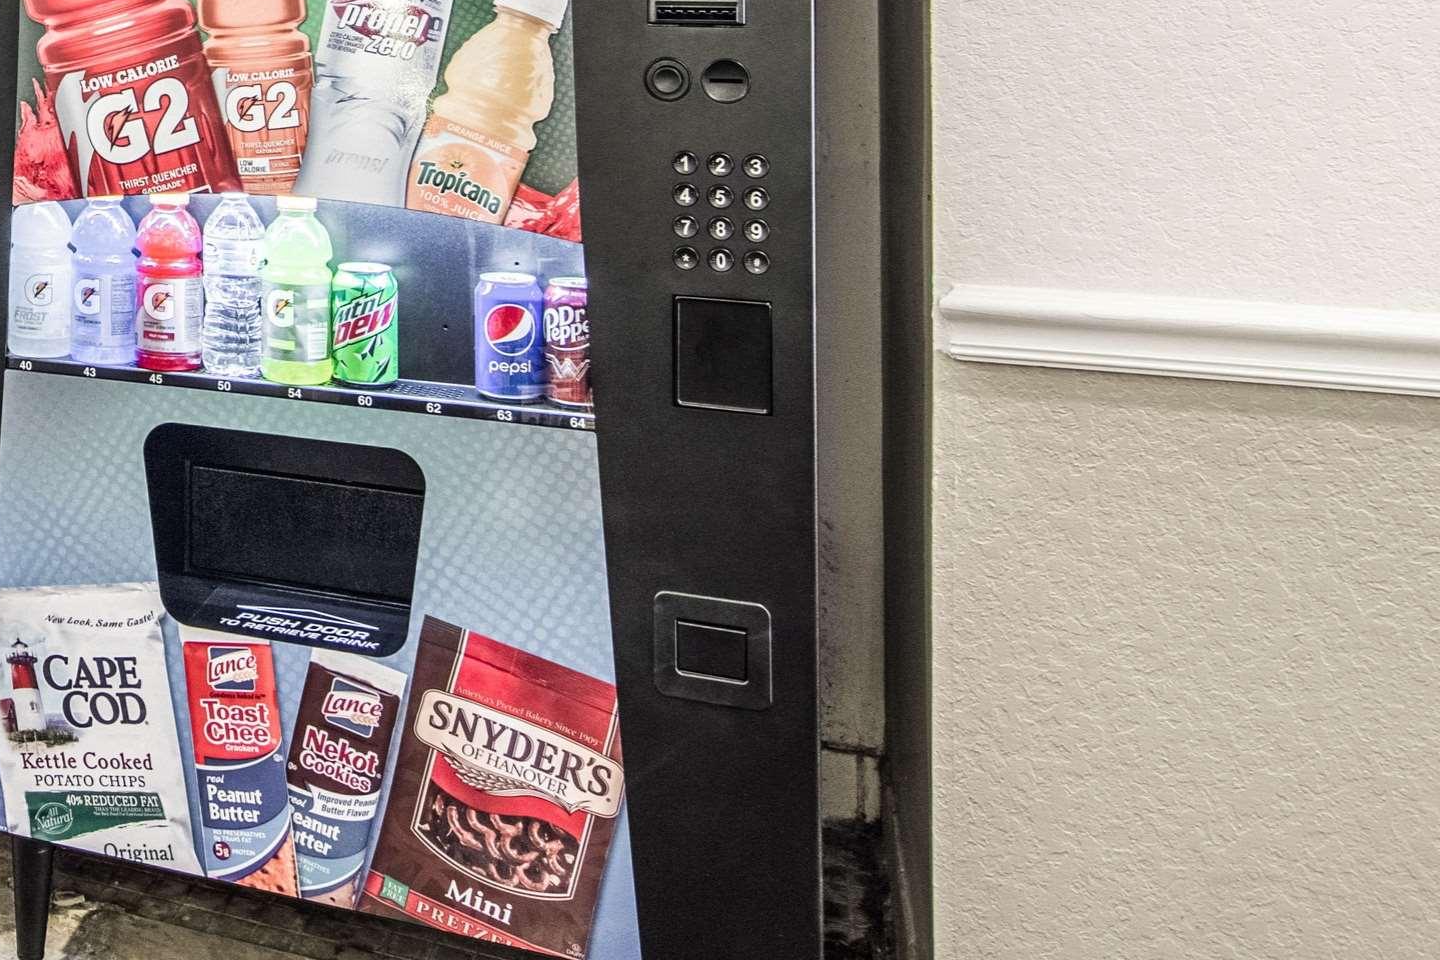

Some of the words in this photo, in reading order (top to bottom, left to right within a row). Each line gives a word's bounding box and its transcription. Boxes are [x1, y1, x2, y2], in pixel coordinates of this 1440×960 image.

[338, 4, 429, 39] propel
[364, 34, 417, 60] zero
[81, 73, 113, 93] LOW
[116, 55, 180, 85] CALORIE
[227, 73, 250, 83] LOW
[251, 68, 295, 81] CALORIE
[226, 81, 301, 133] G2
[86, 77, 201, 165] G2
[447, 124, 486, 144] ORANGE
[487, 139, 511, 153] JUICE
[119, 176, 149, 189] THIRST
[151, 163, 198, 184] QUENCHER
[240, 165, 267, 173] CALORIE
[680, 155, 689, 172] 1
[715, 157, 726, 173] 2
[750, 159, 762, 175] 3
[417, 161, 502, 215] Tropicana
[418, 189, 449, 209] 100%
[680, 187, 691, 204] 4
[715, 189, 726, 205] 5
[750, 191, 762, 207] 6
[680, 219, 691, 235] 7
[715, 221, 726, 237] 8
[750, 223, 762, 240] 9
[715, 253, 727, 269] 0
[24, 274, 54, 307] G
[73, 278, 102, 315] G
[143, 283, 175, 321] G
[267, 289, 295, 328] G
[559, 305, 586, 323] Dr
[488, 359, 532, 376] pepsi
[19, 360, 33, 371] 40
[83, 367, 96, 377] 43
[149, 374, 163, 384] 45
[217, 381, 231, 391] 50
[287, 388, 302, 399] 54
[357, 396, 373, 406] 60
[426, 403, 442, 414] 62
[496, 410, 513, 421] 63
[569, 417, 586, 428] 64
[45, 614, 66, 624] New
[67, 616, 94, 628] Look,
[95, 619, 123, 628] Same
[127, 610, 155, 627] Taste!
[236, 612, 301, 628] PUSH
[303, 623, 370, 640] DOOR
[219, 617, 241, 626] TO
[242, 621, 322, 640] RETRIEVE
[323, 634, 380, 651] DRINK
[42, 654, 142, 691] CAPE
[208, 654, 256, 684] Lance
[62, 690, 148, 728] COD
[201, 700, 269, 725] Toast
[323, 692, 383, 717] Lance
[458, 686, 496, 706] America's
[496, 699, 525, 716] Pretzel
[526, 709, 554, 728] Bakery
[554, 721, 578, 738] Since
[205, 721, 270, 744] Chee
[224, 744, 260, 752] Crackers
[303, 725, 379, 777] Nekot
[428, 700, 613, 798] SNYDER'S
[20, 752, 77, 770] Kettle
[83, 752, 153, 771] Cooked
[300, 750, 372, 793] Cookies
[461, 743, 483, 760] OF
[486, 752, 567, 798] HANOVER
[34, 774, 94, 787] POTATO
[99, 775, 146, 788] CHIPS
[206, 774, 225, 783] real
[65, 794, 84, 807] 40%
[84, 794, 138, 808] REDUCED
[141, 796, 160, 808] FAT
[206, 784, 263, 806] Peanut
[317, 792, 352, 807] Improved
[36, 808, 73, 829] Natural
[48, 806, 59, 817] All
[209, 802, 261, 823] Butter
[321, 804, 346, 816] Butter
[346, 808, 370, 817] Flavor
[292, 811, 341, 841] eanut
[104, 843, 175, 863] Original
[215, 843, 230, 858] 5g
[232, 848, 256, 856] PROTEIN
[294, 830, 333, 856] tter
[382, 888, 405, 904] FREE
[387, 881, 405, 894] FAT
[444, 879, 513, 925] Mini
[415, 901, 511, 945] PRETZE
